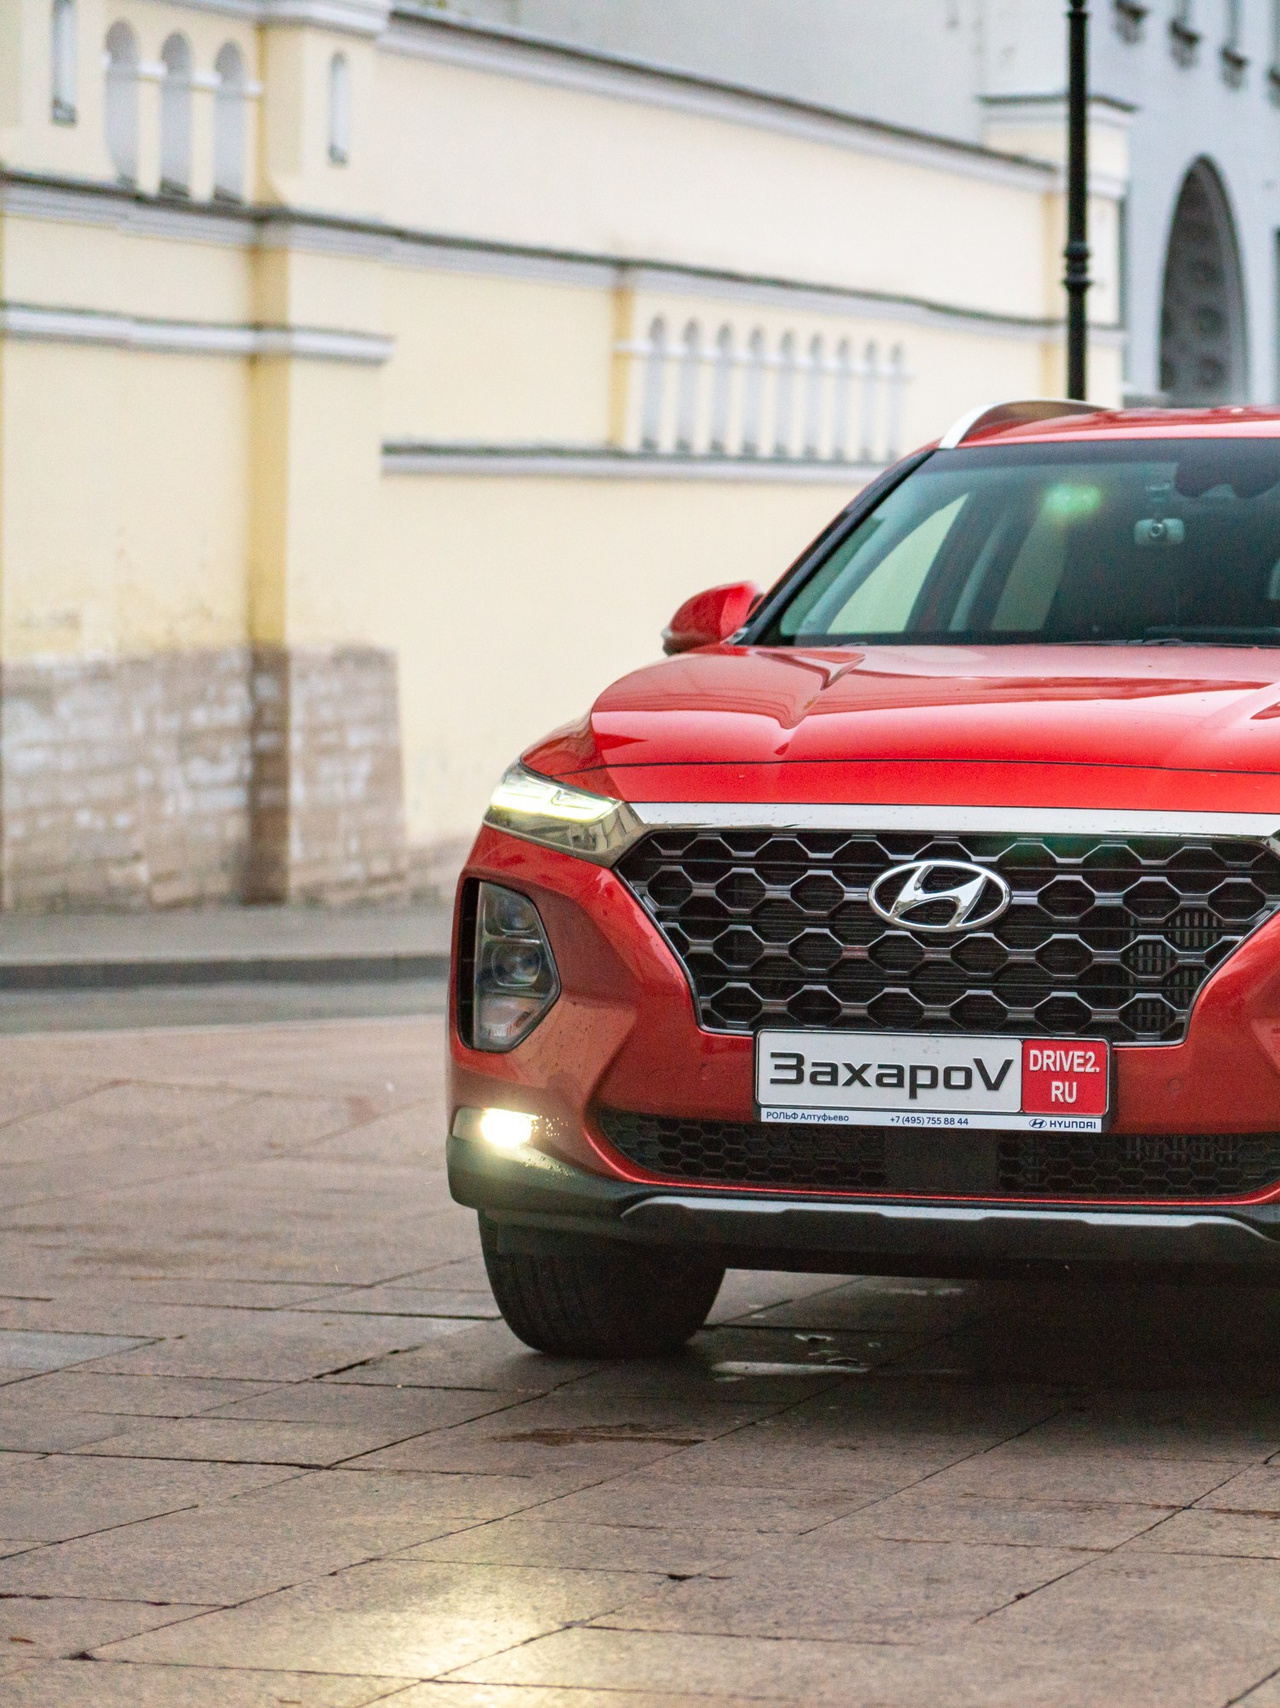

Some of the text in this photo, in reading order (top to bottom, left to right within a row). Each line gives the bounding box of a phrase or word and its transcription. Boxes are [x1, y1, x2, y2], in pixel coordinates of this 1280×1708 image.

[1029, 1049, 1100, 1073] DRIVE2.
[1051, 1081, 1077, 1103] RU
[766, 1111, 849, 1122] РОЛЬФ Алтуфьево
[890, 1116, 969, 1126] +7 (495) 755 88 44
[1049, 1120, 1096, 1129] HYUNDAI
